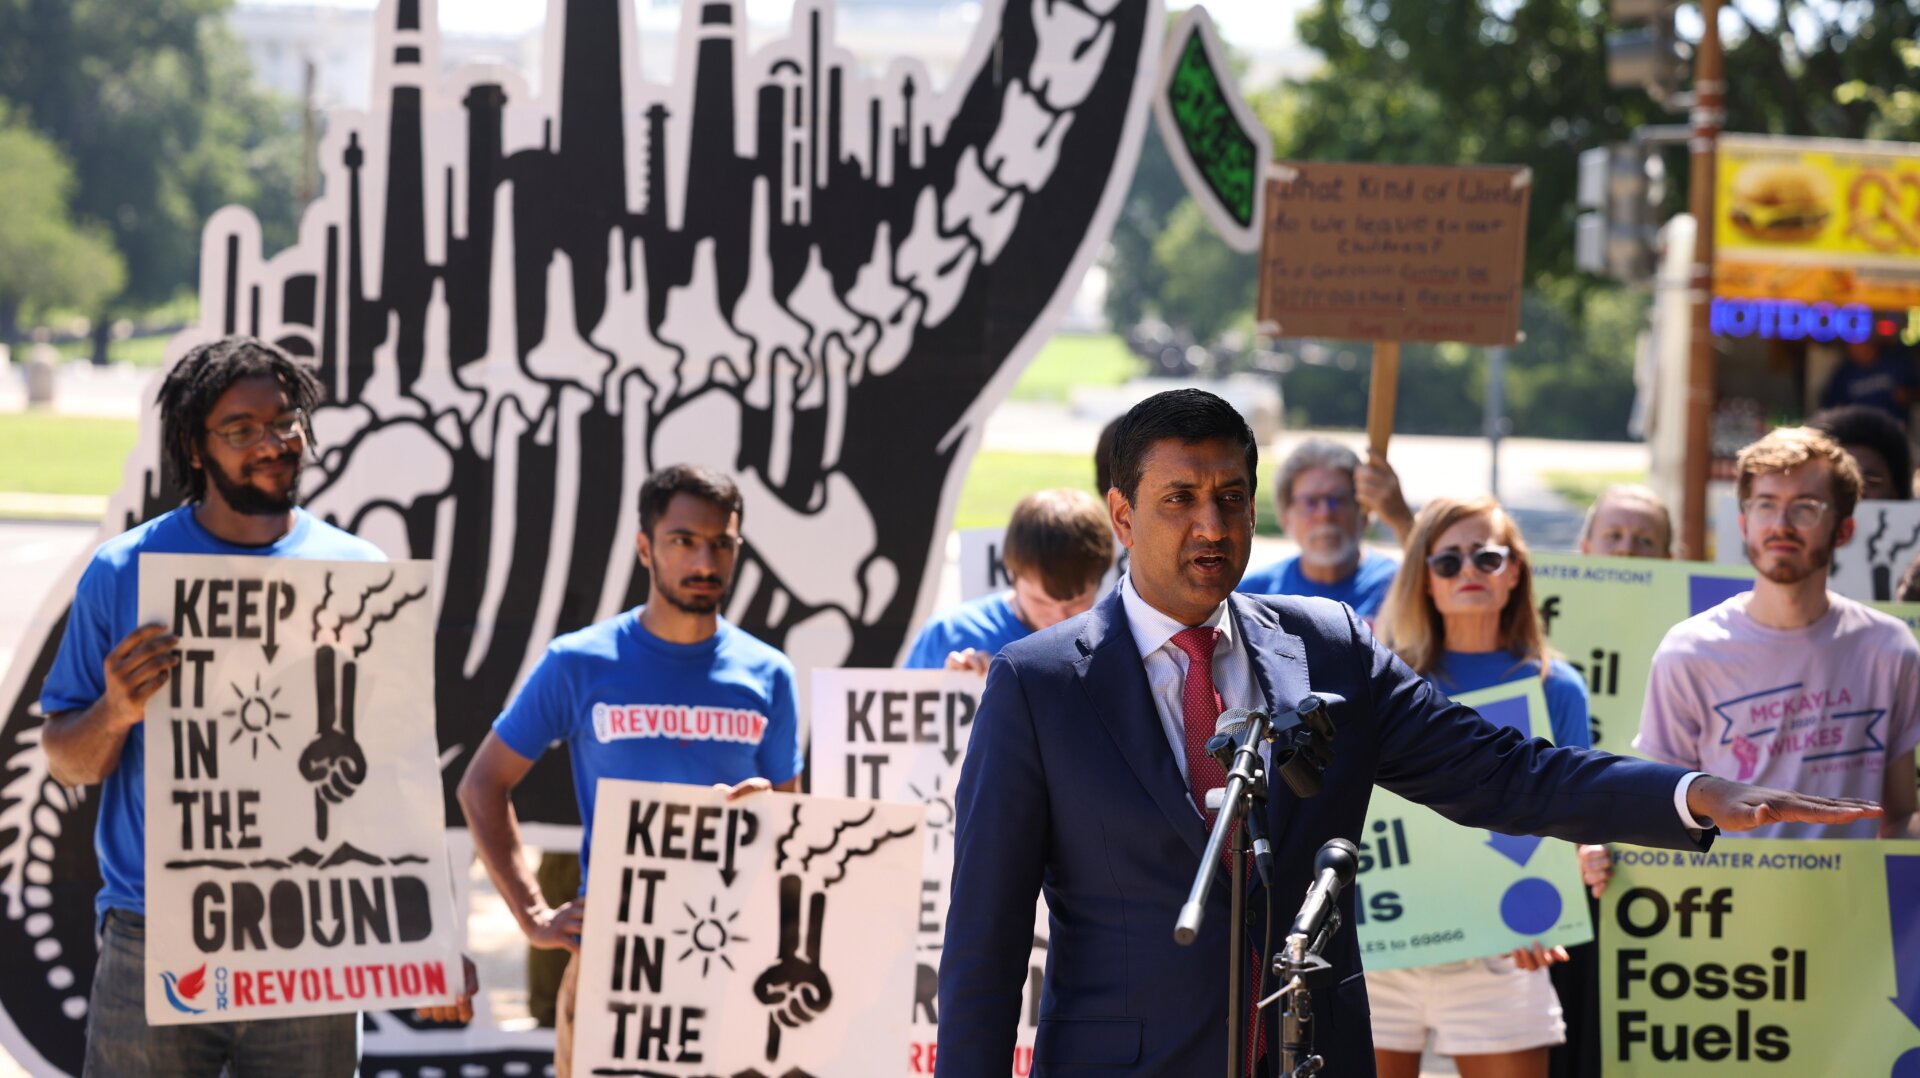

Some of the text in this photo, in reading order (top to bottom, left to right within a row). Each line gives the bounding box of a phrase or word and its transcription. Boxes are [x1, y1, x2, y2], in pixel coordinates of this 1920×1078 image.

[174, 579, 295, 654] KEEP
[171, 650, 214, 708] IT
[1751, 688, 1853, 723] MCKAYLA
[171, 720, 218, 779] IN
[610, 709, 763, 738] REVOLUTION
[846, 690, 975, 757] KEEP
[1767, 727, 1844, 756] WILKES
[846, 753, 889, 800] IT
[172, 791, 261, 850] THE
[626, 800, 757, 877] KEEP
[1613, 850, 1841, 870] FOOD & WATER ACTION!
[192, 876, 432, 953] GROUND
[618, 867, 666, 924] IT
[1615, 887, 1733, 939] Off
[215, 961, 447, 1010] OUR REVOLUTION
[610, 935, 665, 993] IN
[1616, 946, 1807, 1002] Fossil
[608, 1001, 706, 1064] THE
[1617, 1008, 1791, 1062] Fuels
